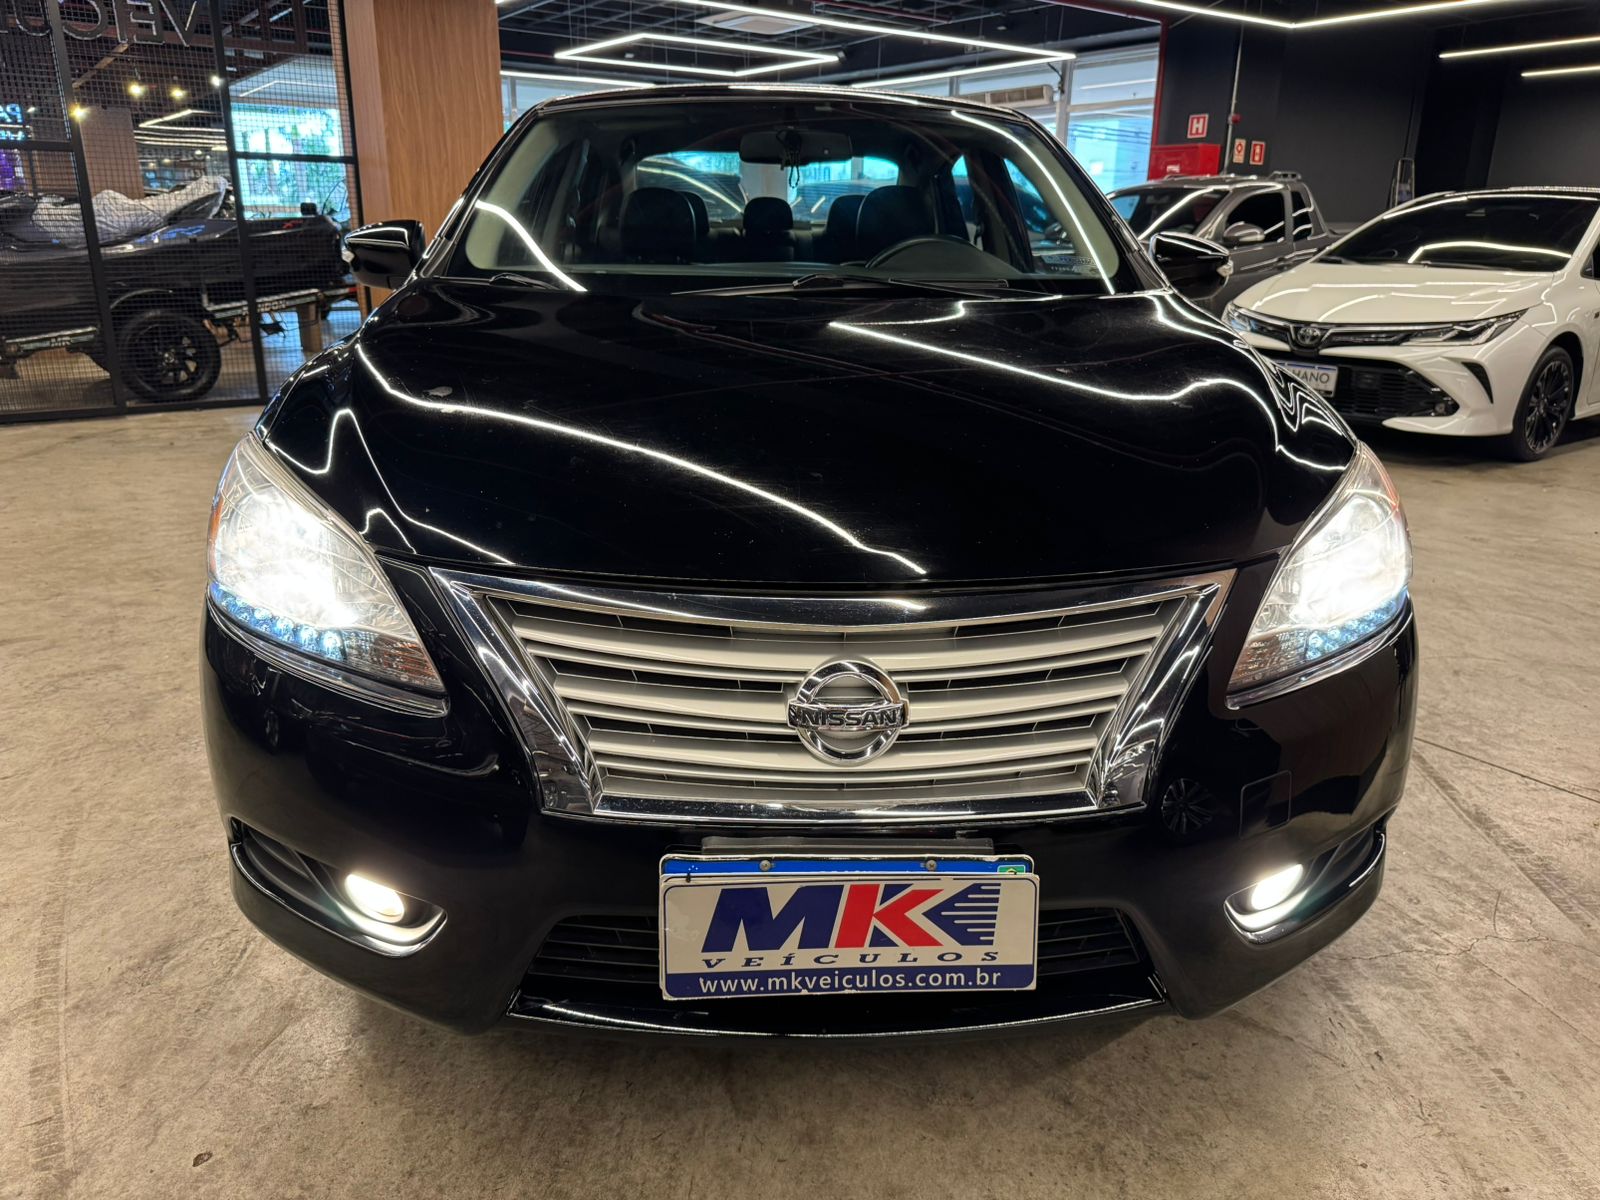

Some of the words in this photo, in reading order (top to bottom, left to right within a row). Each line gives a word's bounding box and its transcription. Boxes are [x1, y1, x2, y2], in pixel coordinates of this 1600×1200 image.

[799, 708, 899, 727] NISSAN
[701, 883, 945, 953] MK
[701, 951, 1000, 968] VEÍCULOS
[699, 968, 1002, 993] www.mkveiculos.com.br
